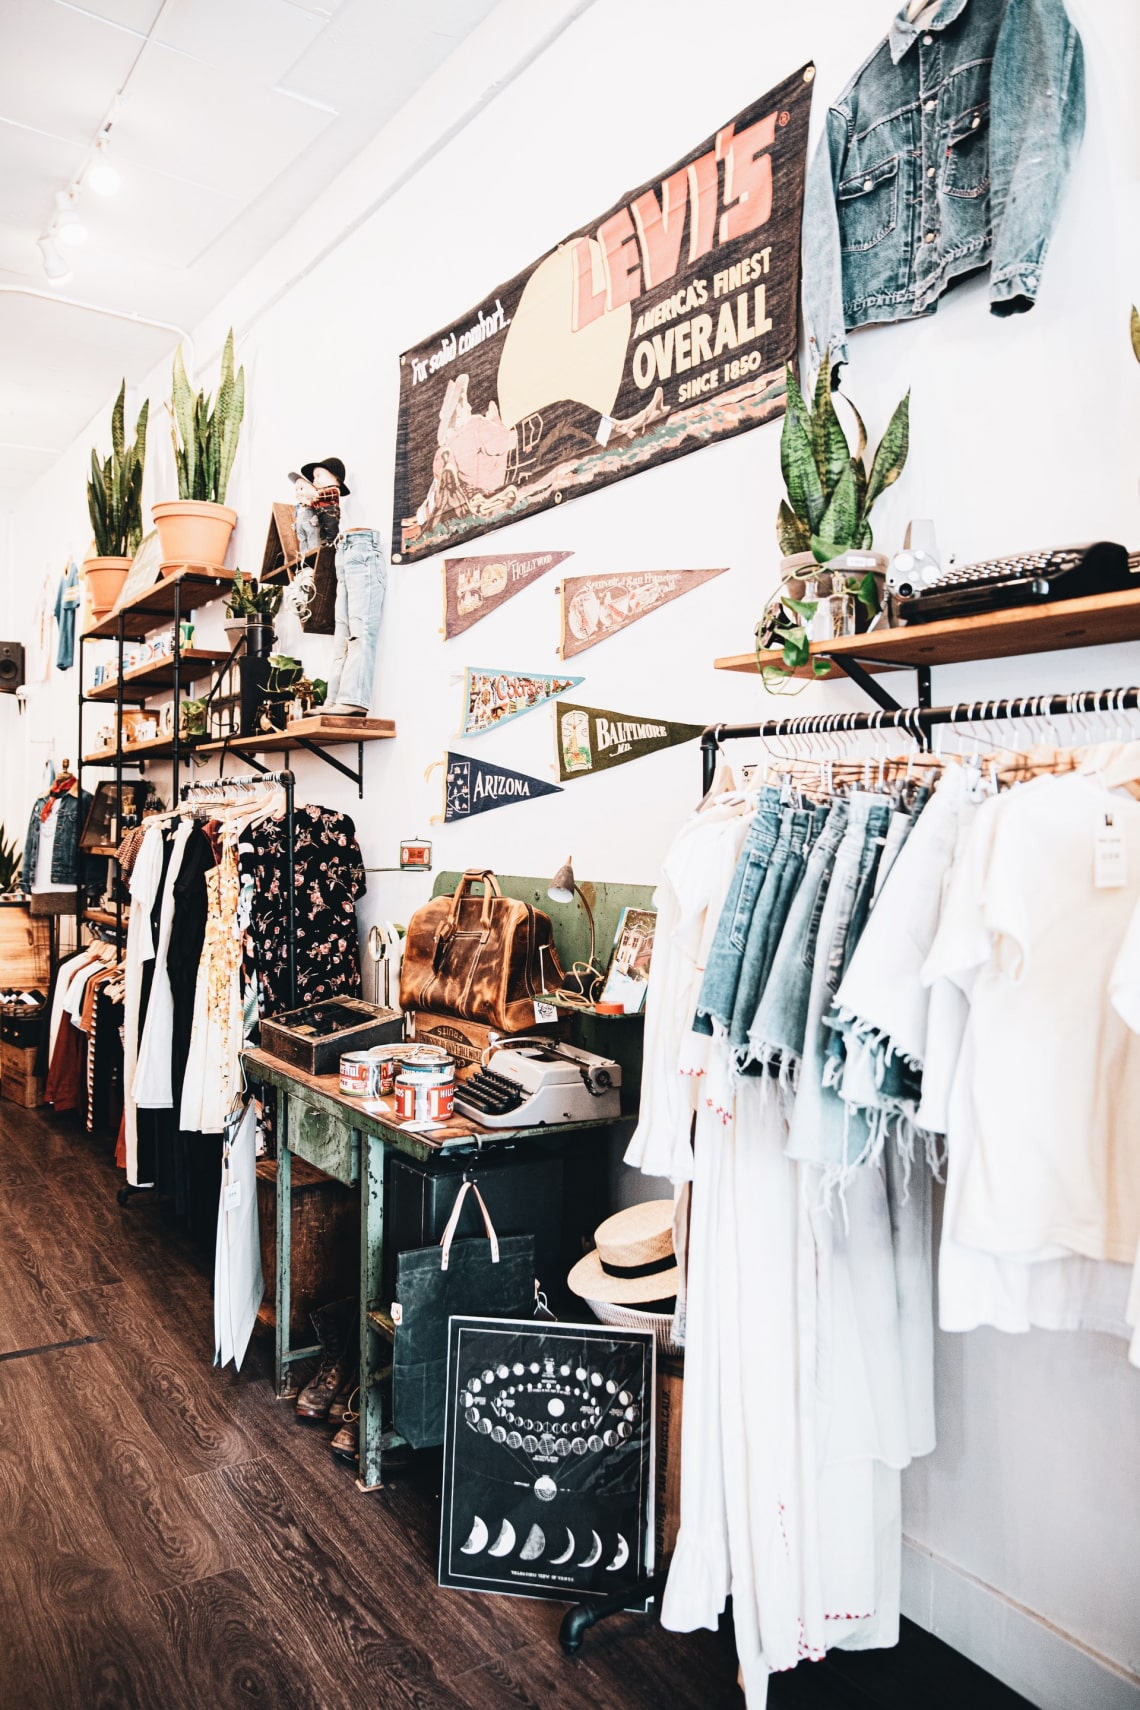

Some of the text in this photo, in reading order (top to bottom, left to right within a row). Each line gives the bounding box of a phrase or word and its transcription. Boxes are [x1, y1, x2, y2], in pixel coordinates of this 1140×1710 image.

[571, 110, 778, 333] LEVI'S
[633, 246, 773, 340] AMERICA'S FINEST
[411, 298, 511, 386] For solid comfort.
[632, 283, 773, 390] OVERALL
[678, 350, 762, 403] SINCE 1850
[511, 554, 552, 582] HOLLYWOOD
[595, 718, 668, 752] BALTIMORE
[472, 770, 531, 802] ARIZONA
[437, 1027, 464, 1042] FRUITS
